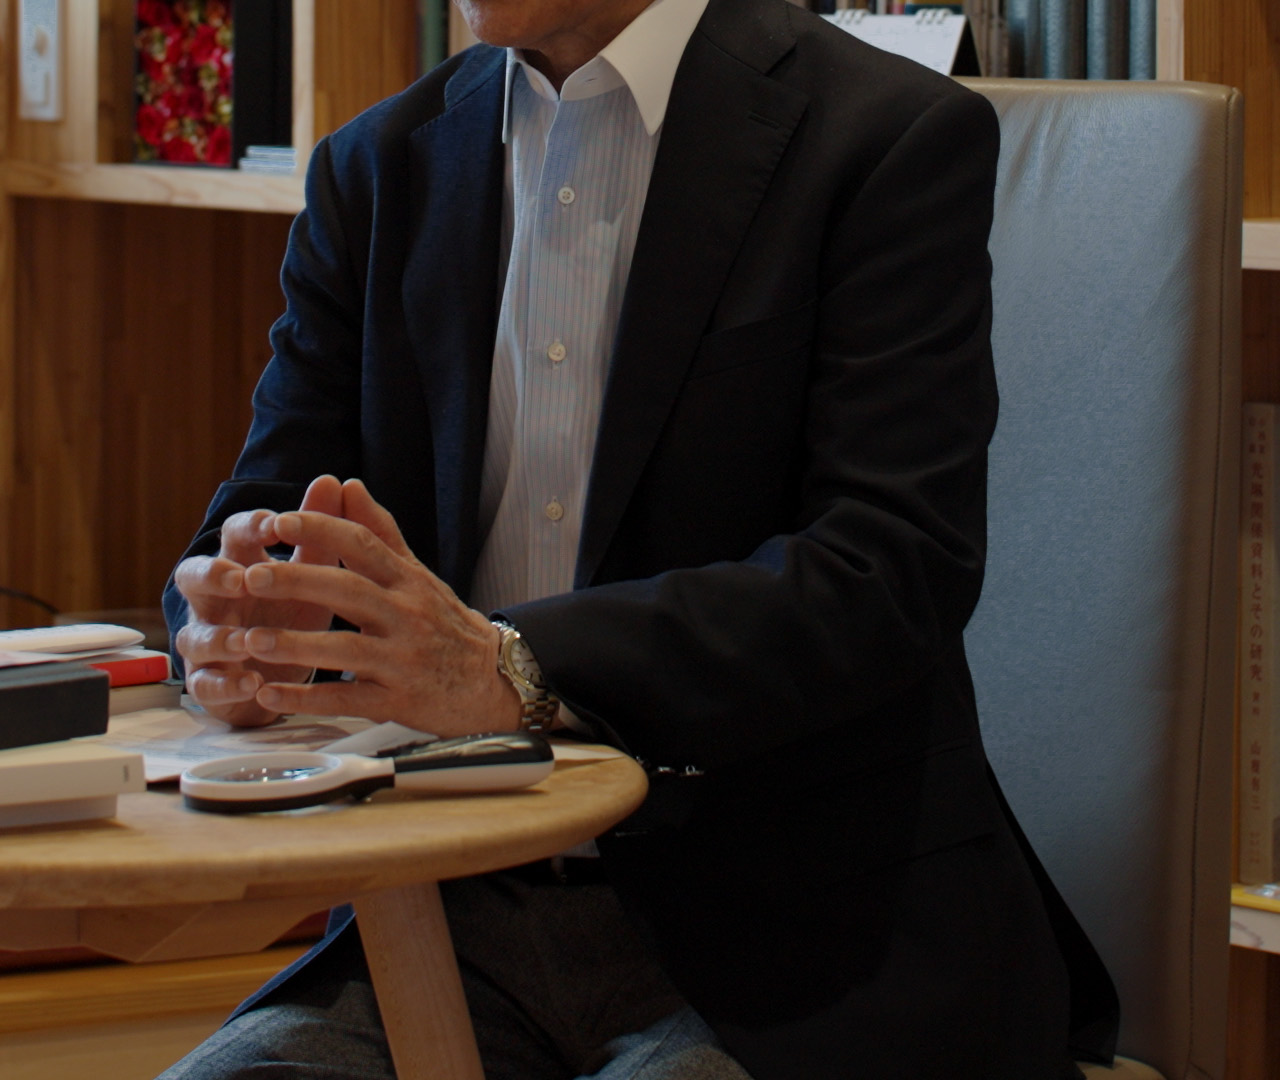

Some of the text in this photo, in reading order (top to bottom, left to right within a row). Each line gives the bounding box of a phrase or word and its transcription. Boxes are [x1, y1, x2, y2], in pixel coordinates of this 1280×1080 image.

[1248, 460, 1265, 682] 光琳関係資料とその研究
